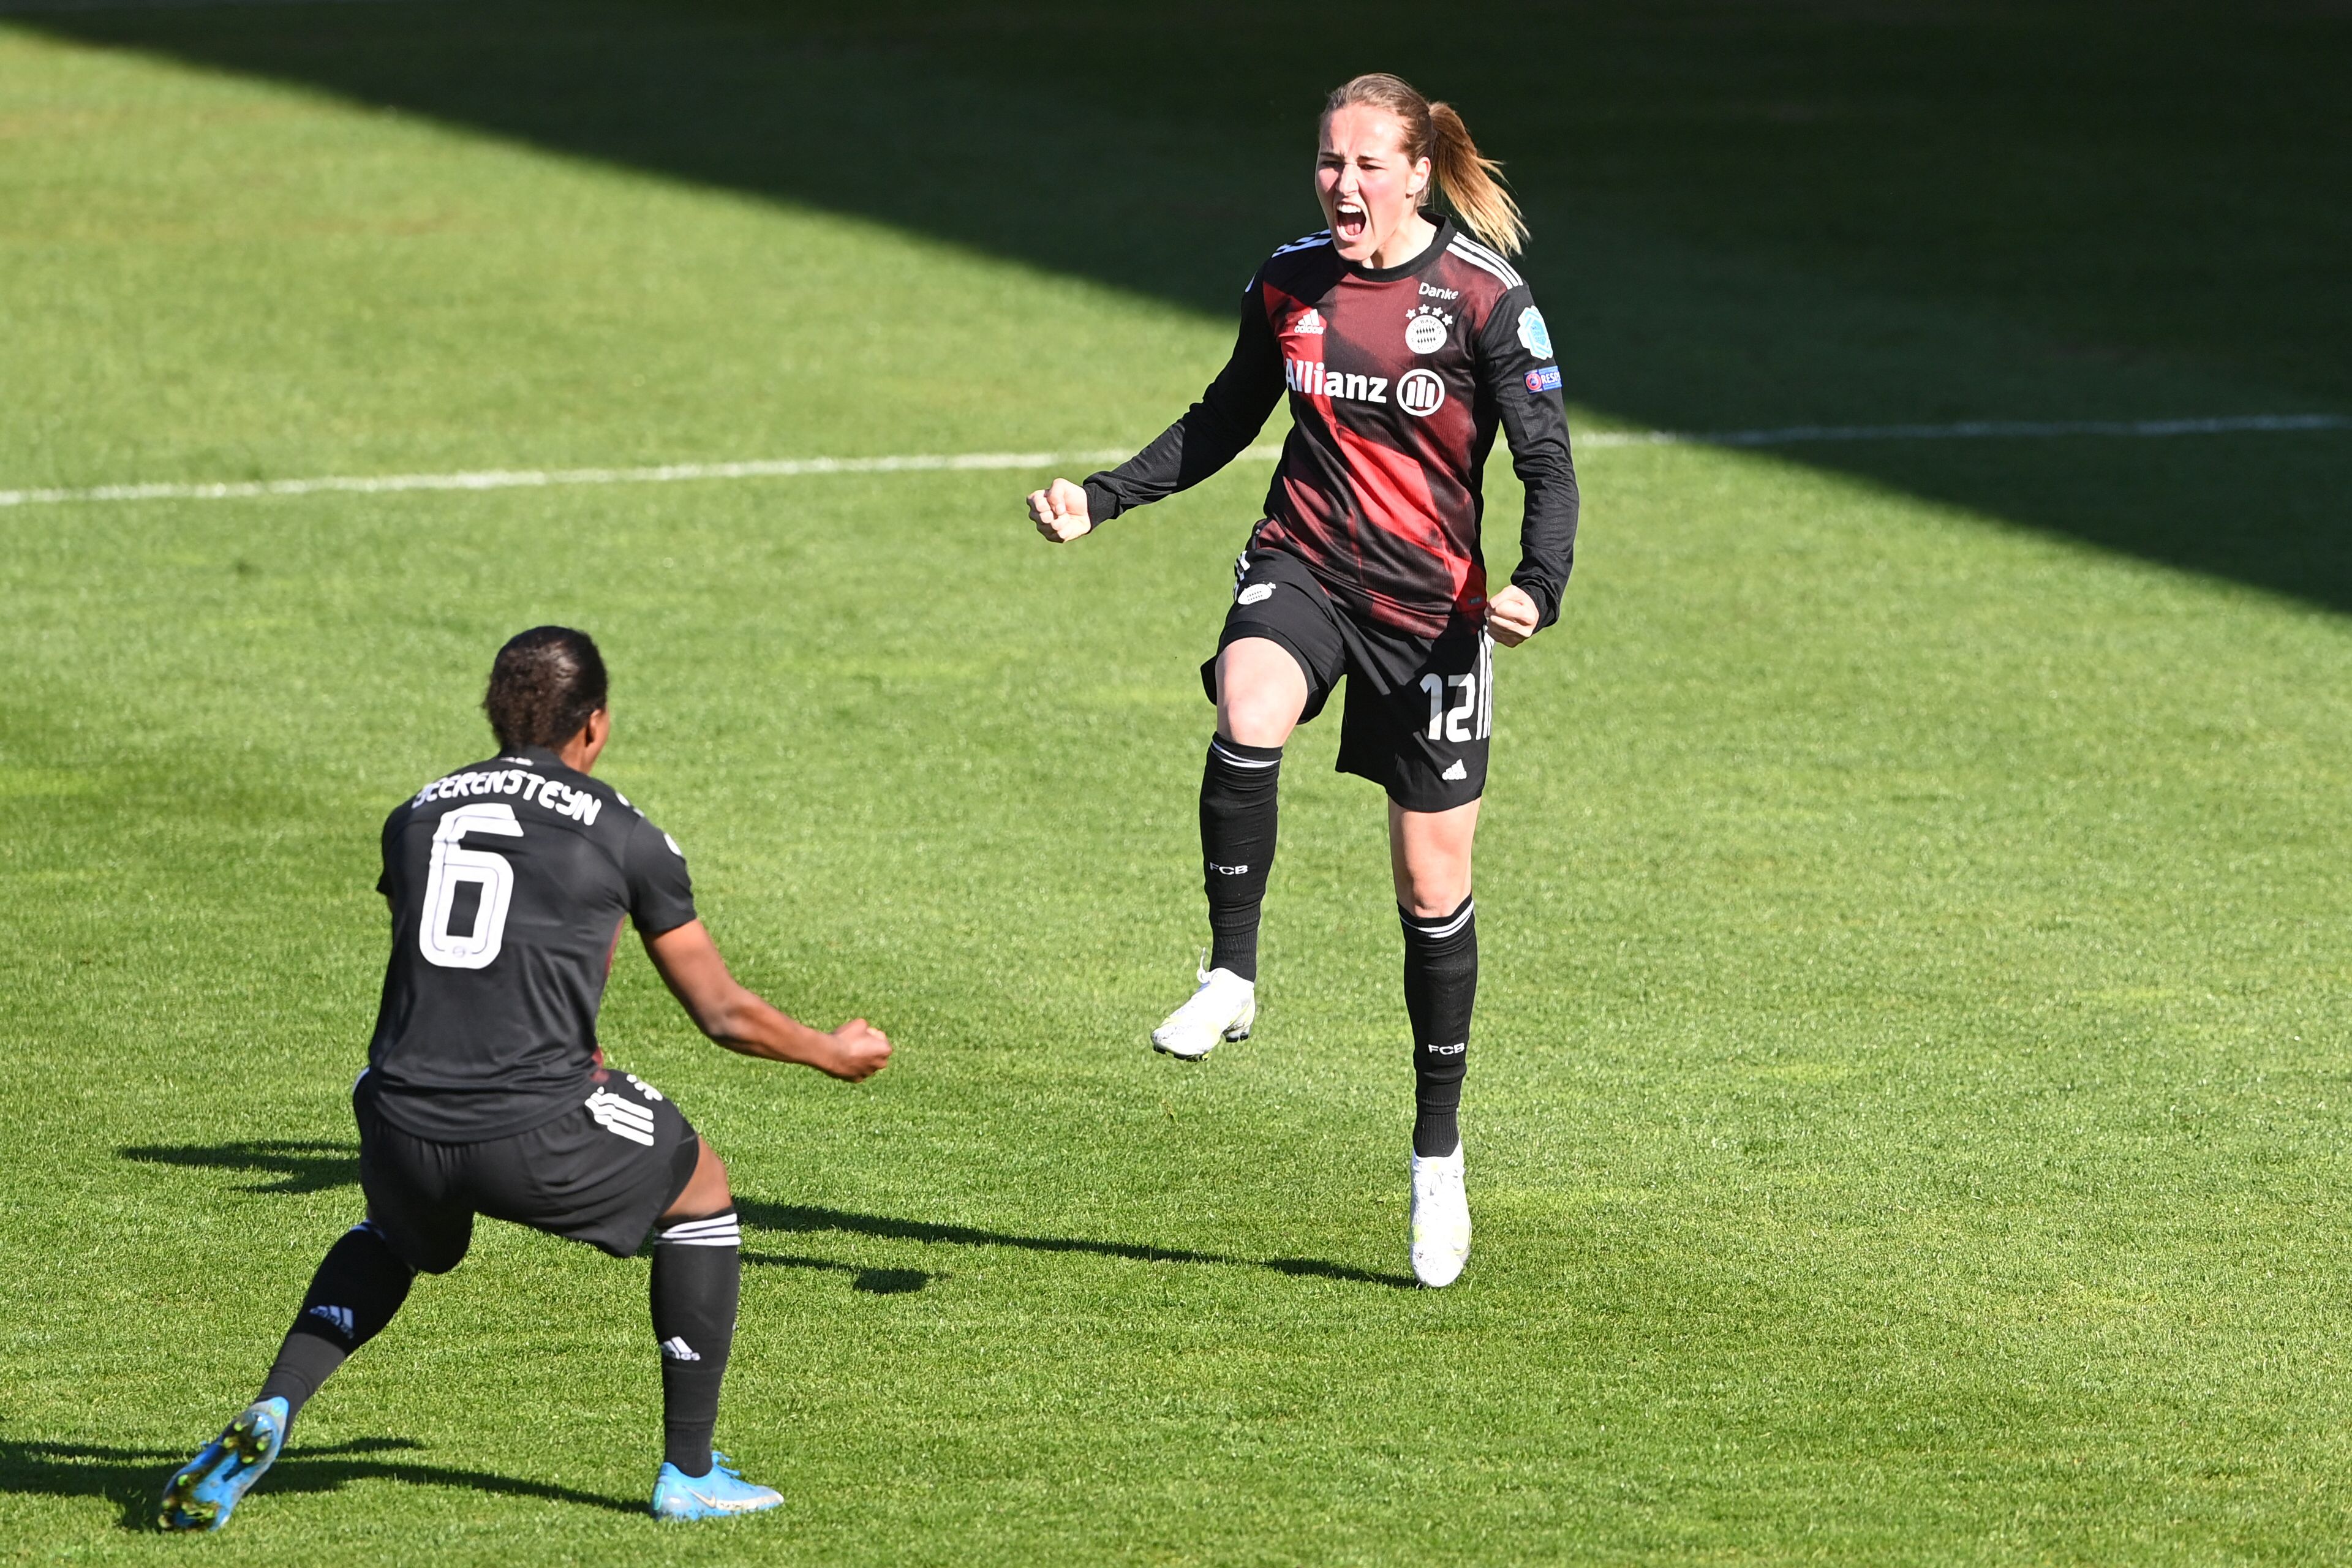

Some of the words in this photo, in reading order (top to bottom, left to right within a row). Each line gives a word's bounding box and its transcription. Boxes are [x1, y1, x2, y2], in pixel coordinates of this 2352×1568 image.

[1418, 282, 1459, 300] Danke
[1286, 358, 1388, 404] Allianz
[1419, 673, 1476, 743] 12
[1209, 862, 1248, 875] FCB
[419, 802, 524, 970] 6
[1428, 1042, 1465, 1055] FCB
